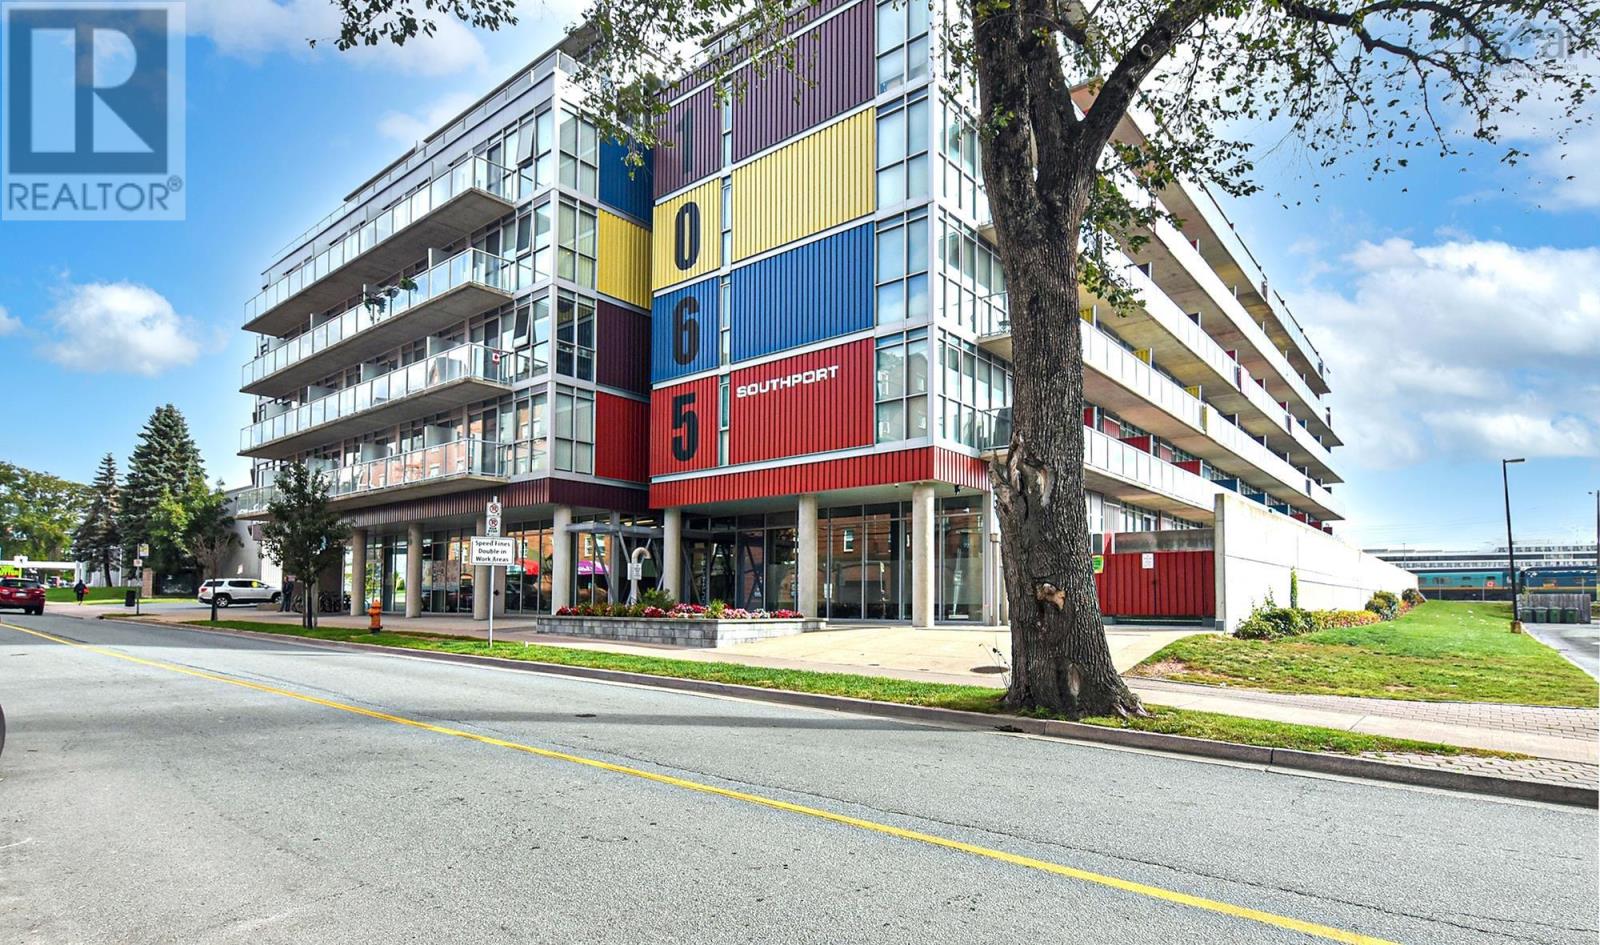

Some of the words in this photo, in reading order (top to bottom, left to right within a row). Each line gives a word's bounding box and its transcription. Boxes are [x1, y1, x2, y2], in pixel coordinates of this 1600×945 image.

[674, 201, 701, 271] 0
[672, 296, 700, 366] 6
[736, 365, 839, 398] SOUTHPORT
[672, 392, 699, 462] 5
